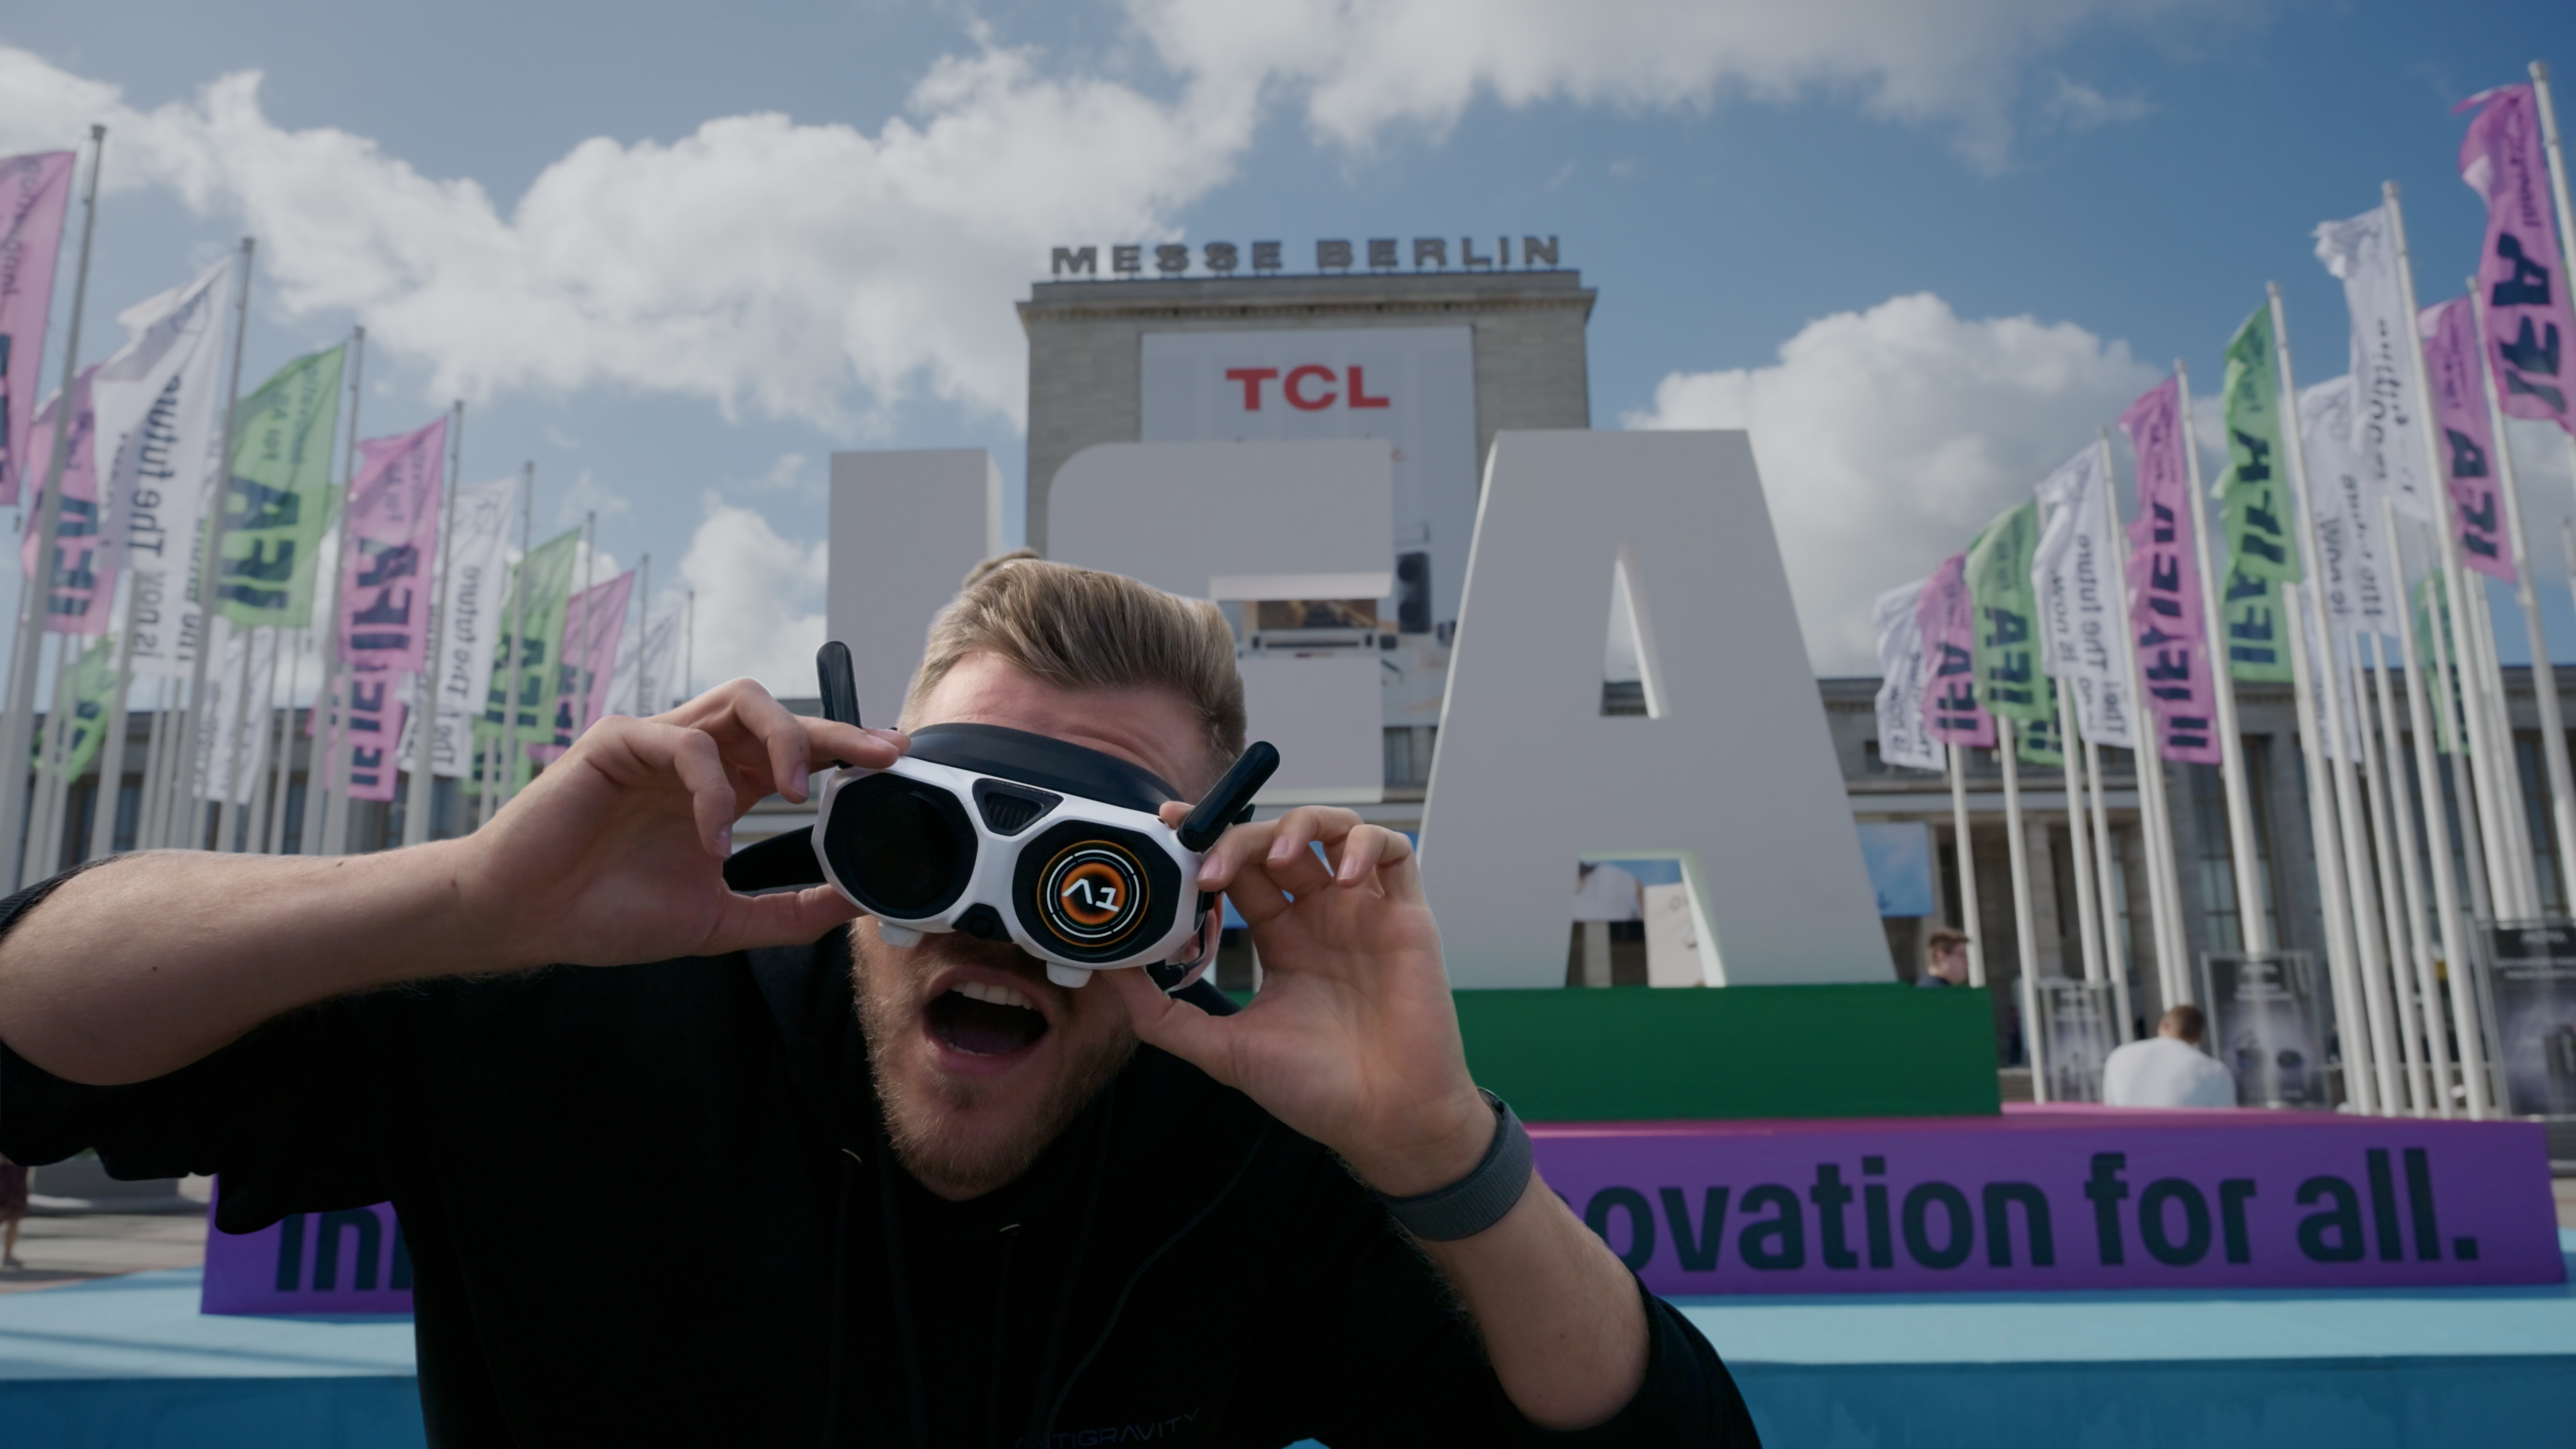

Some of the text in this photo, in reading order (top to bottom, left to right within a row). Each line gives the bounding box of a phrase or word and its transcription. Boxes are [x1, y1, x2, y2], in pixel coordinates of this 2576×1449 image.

[1051, 236, 1559, 274] MESSE BERLIN
[1226, 364, 1391, 411] TCL
[2086, 1153, 2256, 1267] for
[2296, 1146, 2481, 1265] all.
